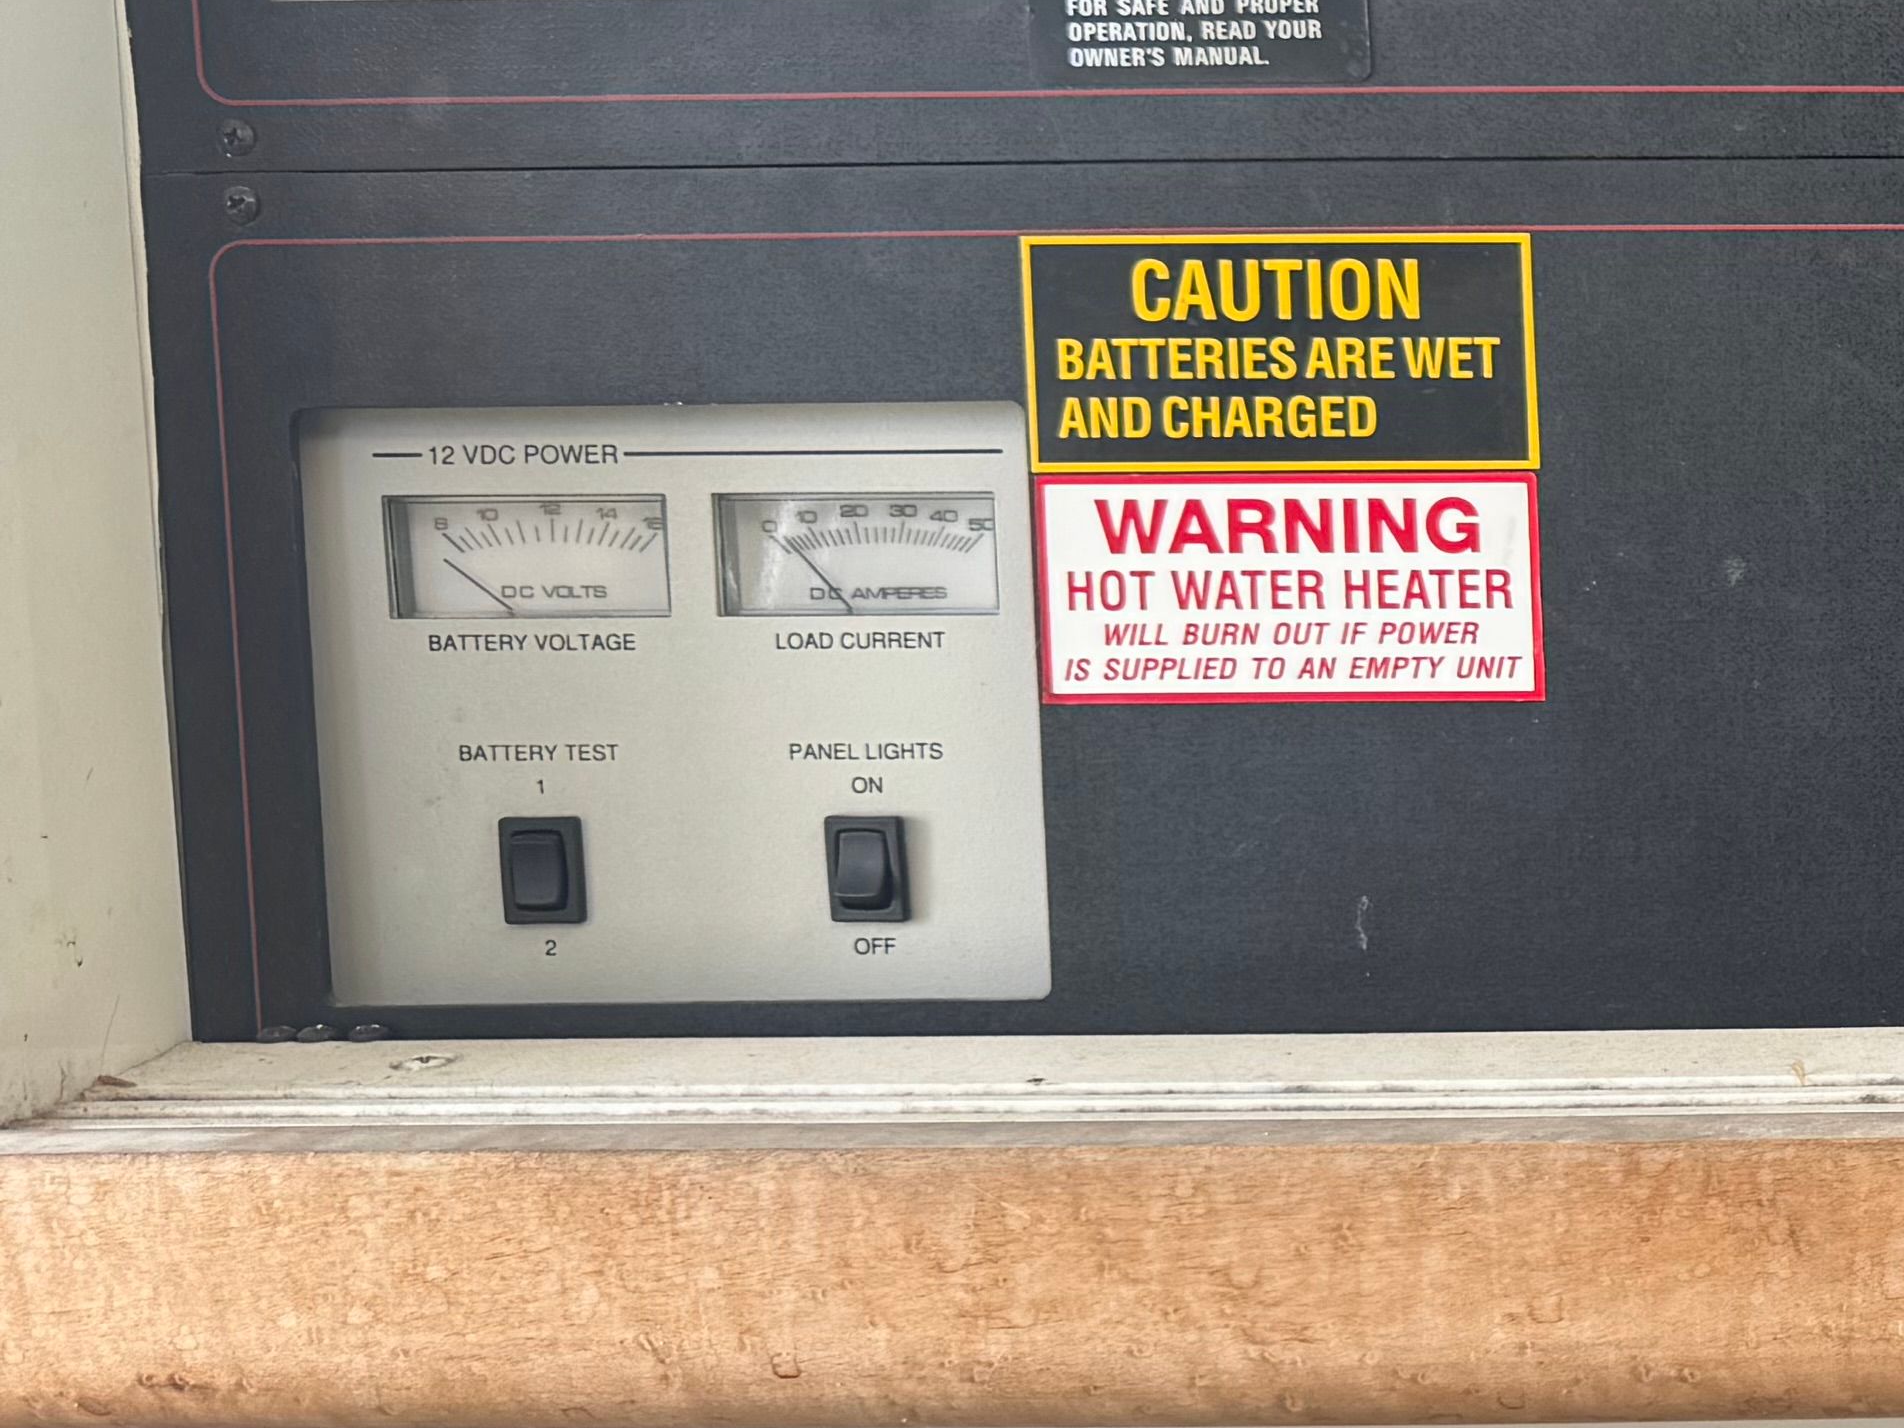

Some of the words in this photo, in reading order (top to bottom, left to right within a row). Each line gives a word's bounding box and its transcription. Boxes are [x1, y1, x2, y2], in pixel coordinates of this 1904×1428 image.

[1067, 21, 1193, 43] OPERATION,
[1200, 20, 1257, 40] READ
[1262, 18, 1322, 40] YOUR
[1069, 46, 1165, 68] OWNER'S
[1172, 45, 1270, 66] MANUAL.
[1131, 258, 1421, 322] CAUTION
[1055, 336, 1297, 383] BATTERIES
[1304, 336, 1397, 381] ARE
[1404, 337, 1500, 378] WET
[1059, 397, 1151, 438] AND
[1162, 396, 1377, 438] CHARGED
[428, 445, 455, 465] 12
[462, 444, 516, 465] VDC
[524, 444, 618, 465] POWER
[1094, 496, 1480, 555] WARNING
[1067, 569, 1156, 612] HOT
[1170, 569, 1325, 610] WATER
[1343, 568, 1513, 610] HEATER
[428, 633, 528, 652] BATTERY
[533, 633, 636, 652] VOLTAGE
[1104, 623, 1169, 646] WILL
[1182, 622, 1260, 646] BURN
[1273, 621, 1331, 646] OUT
[1340, 621, 1368, 645] IF
[1378, 621, 1480, 645] POWER
[1064, 658, 1091, 682] IS
[1103, 657, 1238, 681] SUPPLIED
[1251, 656, 1286, 680] TO
[1298, 657, 1341, 679] AN
[1348, 656, 1445, 679] EMPTY
[1456, 655, 1523, 679] UNIT
[458, 744, 558, 762] BATTERY
[564, 743, 619, 762] TEST
[789, 742, 860, 761] PANEL
[865, 742, 944, 761] LIGHTS
[851, 776, 883, 794] ON
[853, 937, 896, 956] OFF
